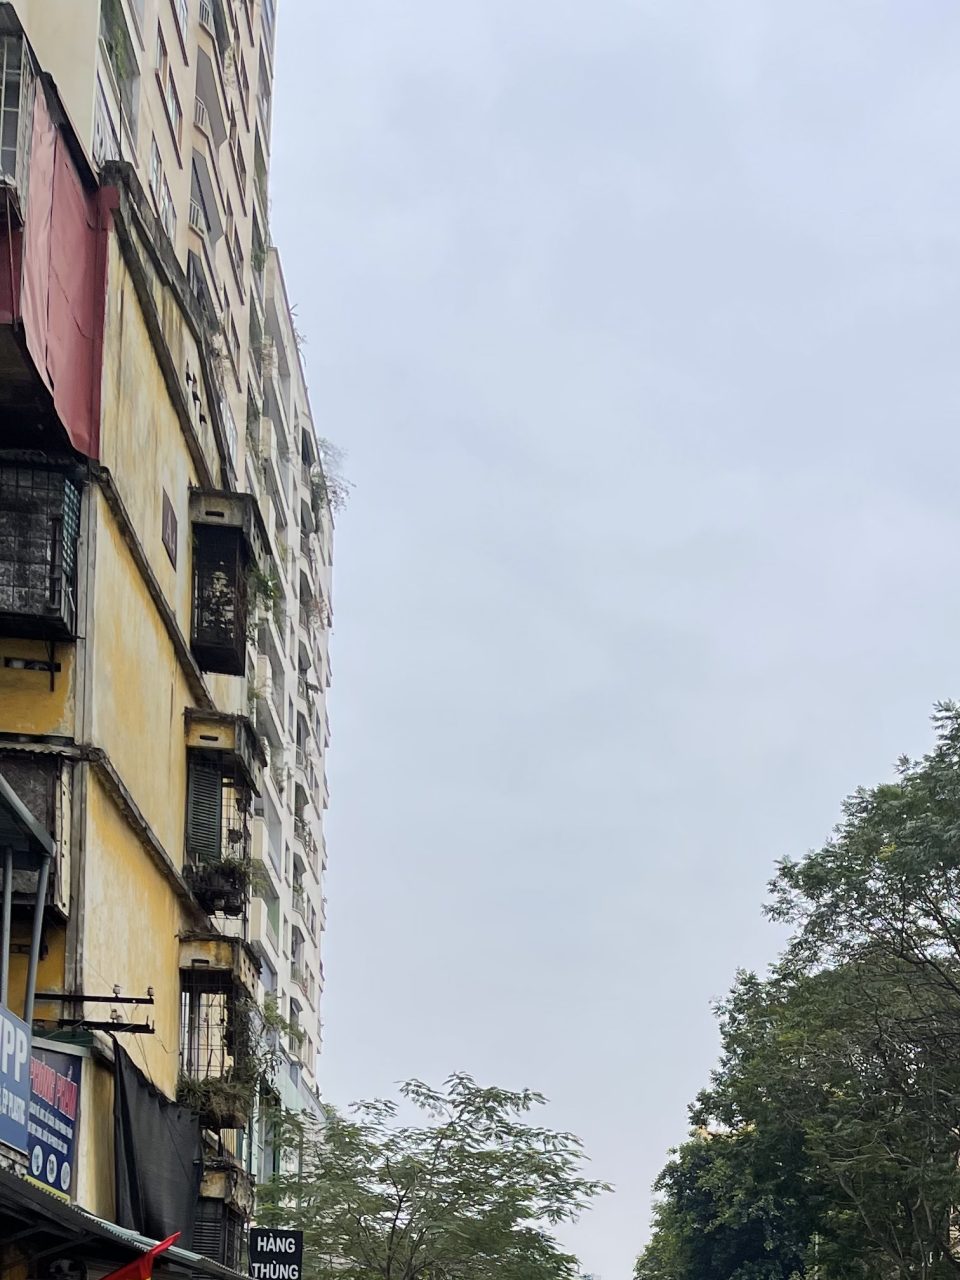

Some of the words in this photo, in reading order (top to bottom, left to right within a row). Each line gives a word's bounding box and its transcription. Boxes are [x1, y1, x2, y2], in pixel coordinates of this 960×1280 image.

[0, 1013, 28, 1082] PP
[257, 1233, 296, 1254] HÀNG
[252, 1260, 299, 1280] THÙNG
